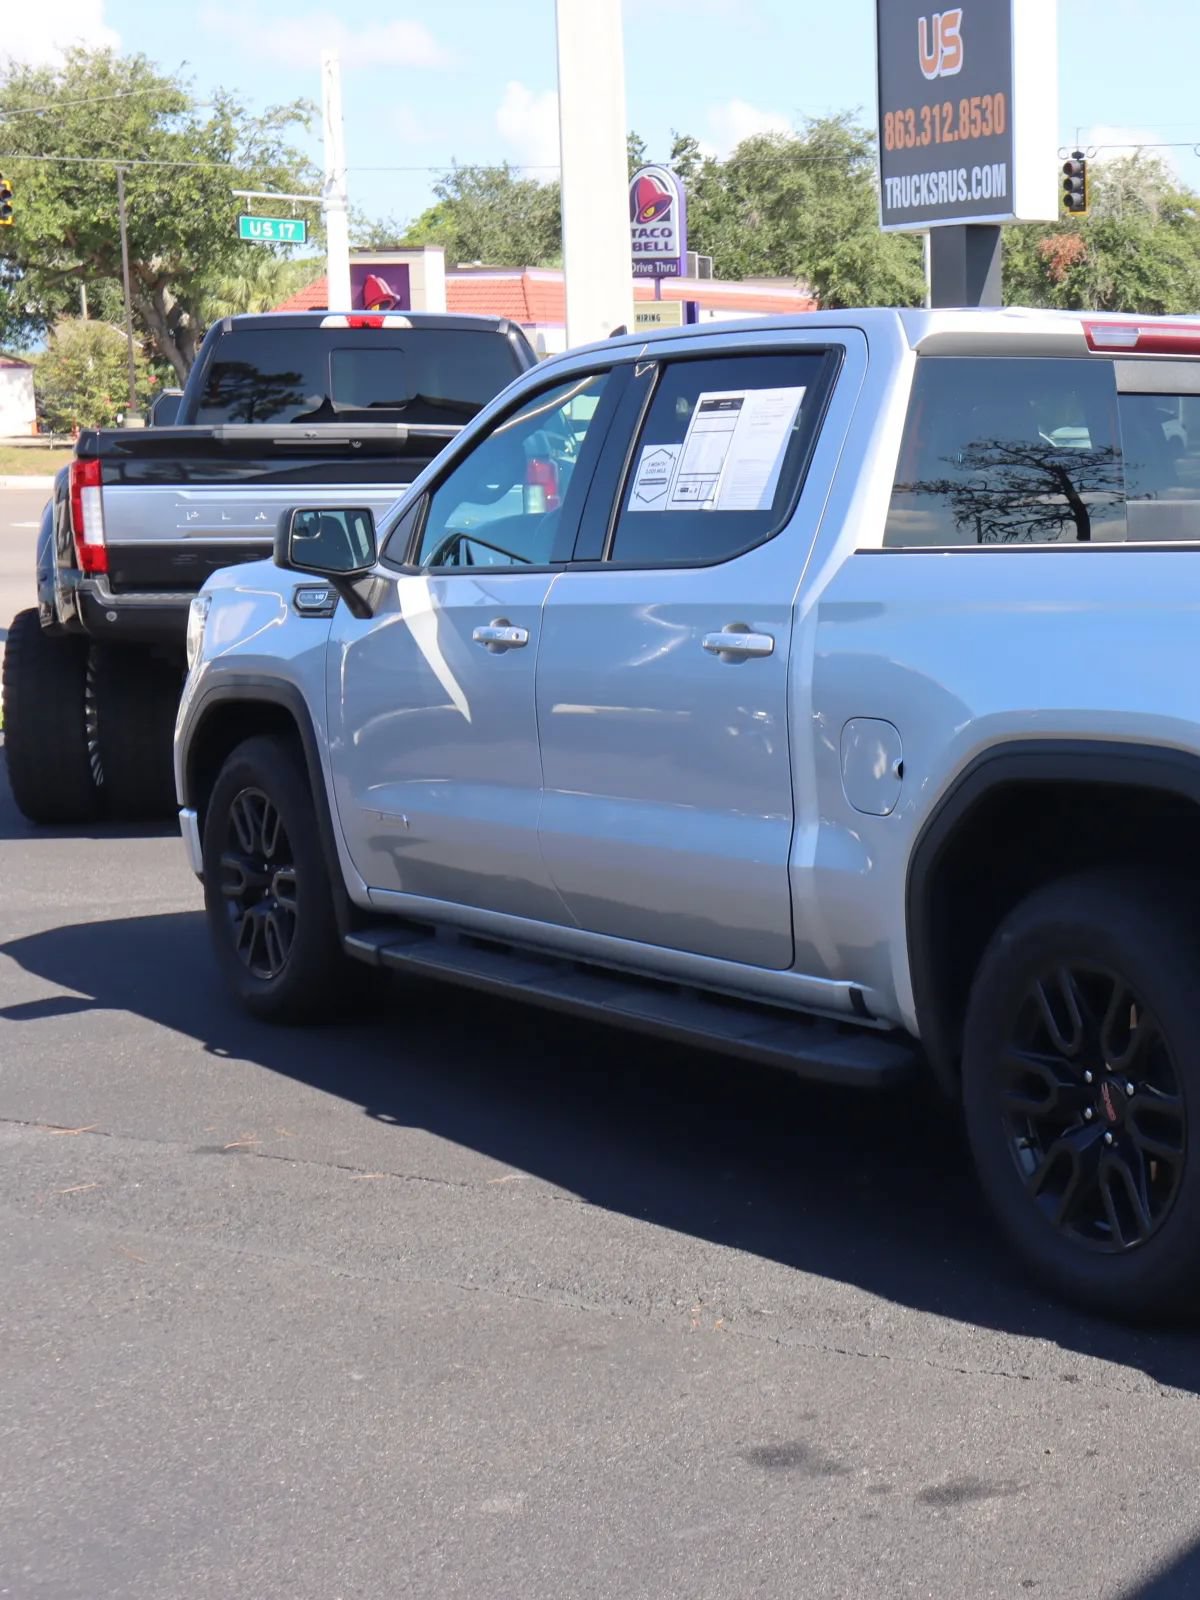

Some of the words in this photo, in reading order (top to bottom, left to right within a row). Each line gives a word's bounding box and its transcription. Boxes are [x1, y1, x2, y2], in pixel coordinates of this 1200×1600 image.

[918, 7, 964, 81] US
[884, 92, 1006, 152] 863.312.8530
[885, 163, 1007, 210] TRUCKSRUS.COM
[249, 220, 273, 237] US
[278, 223, 295, 239] 17
[631, 227, 673, 239] TACO
[632, 241, 675, 252] BELL
[631, 261, 654, 273] Drive
[655, 261, 677, 273] Thru
